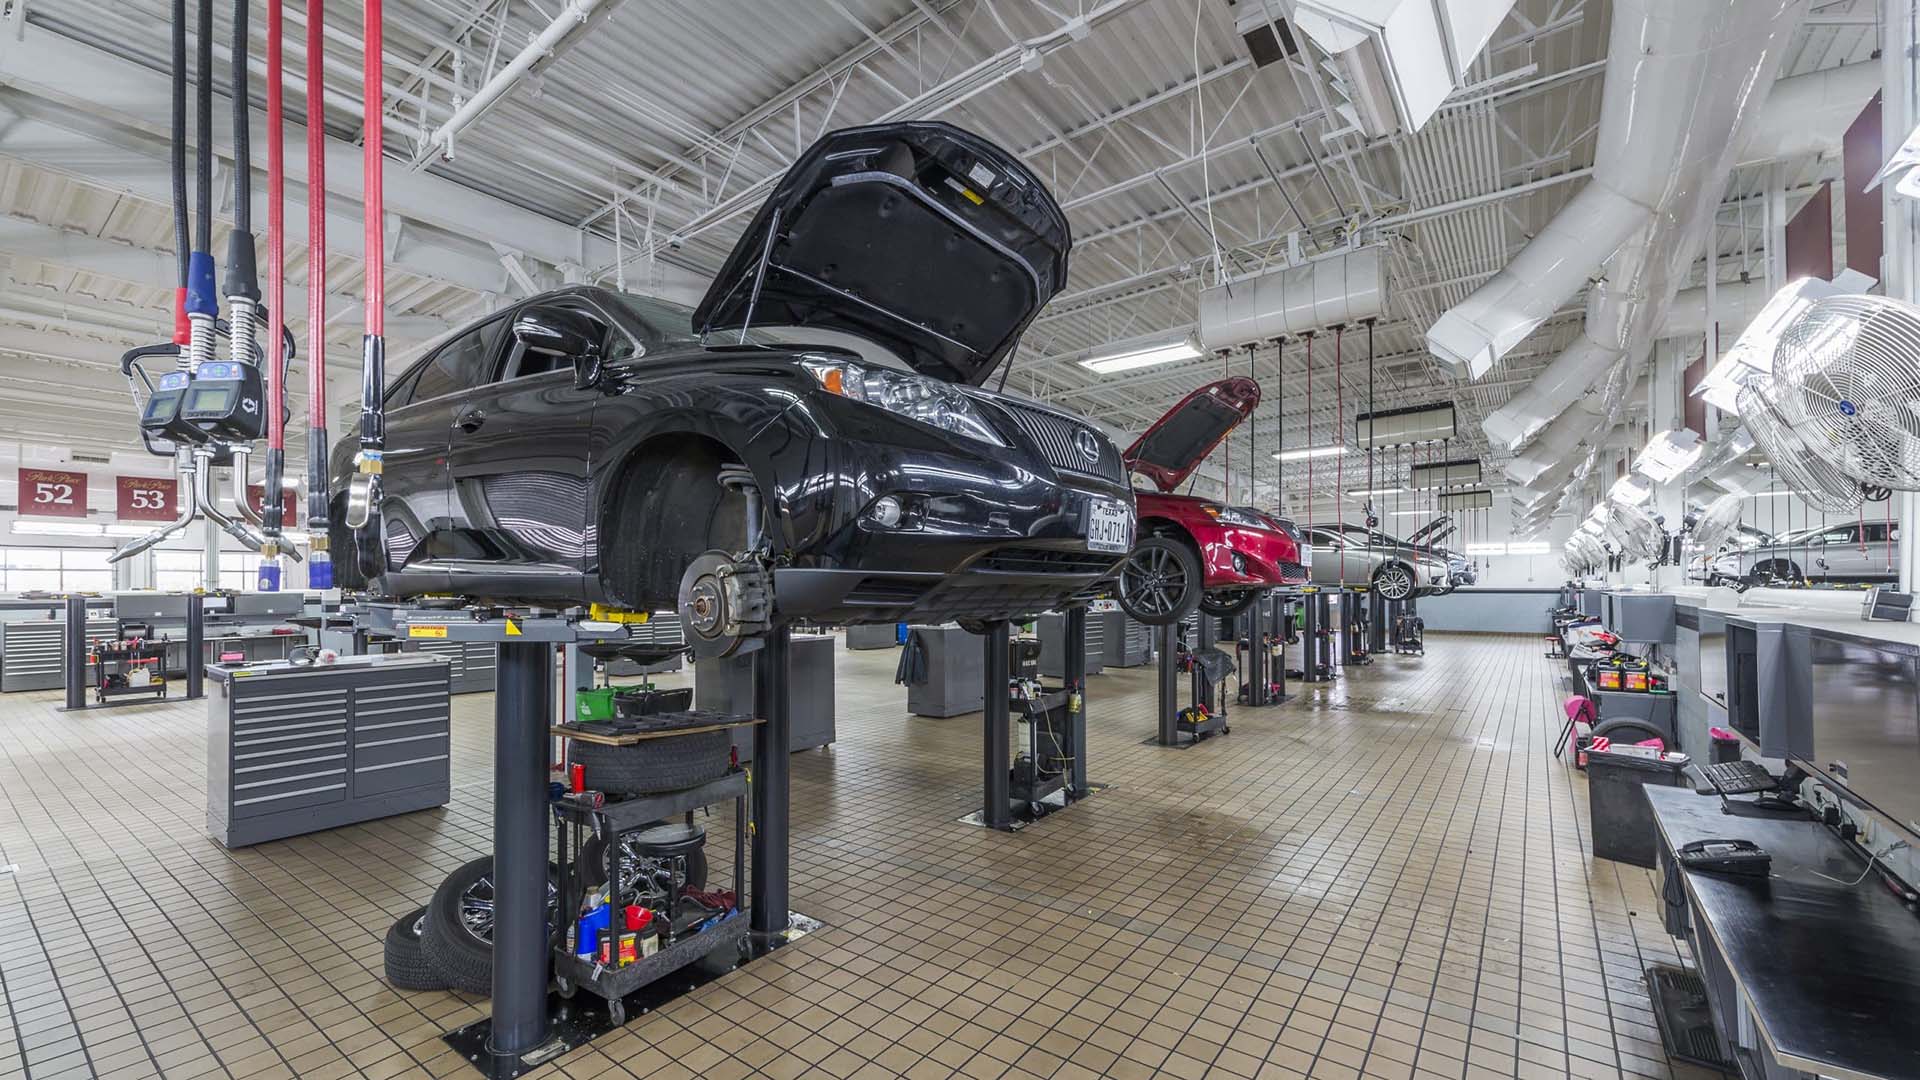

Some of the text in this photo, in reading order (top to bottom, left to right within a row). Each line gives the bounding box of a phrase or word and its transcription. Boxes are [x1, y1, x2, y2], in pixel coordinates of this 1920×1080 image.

[34, 483, 73, 504] 52
[131, 489, 165, 509] 53
[1102, 508, 1118, 517] TEXAS
